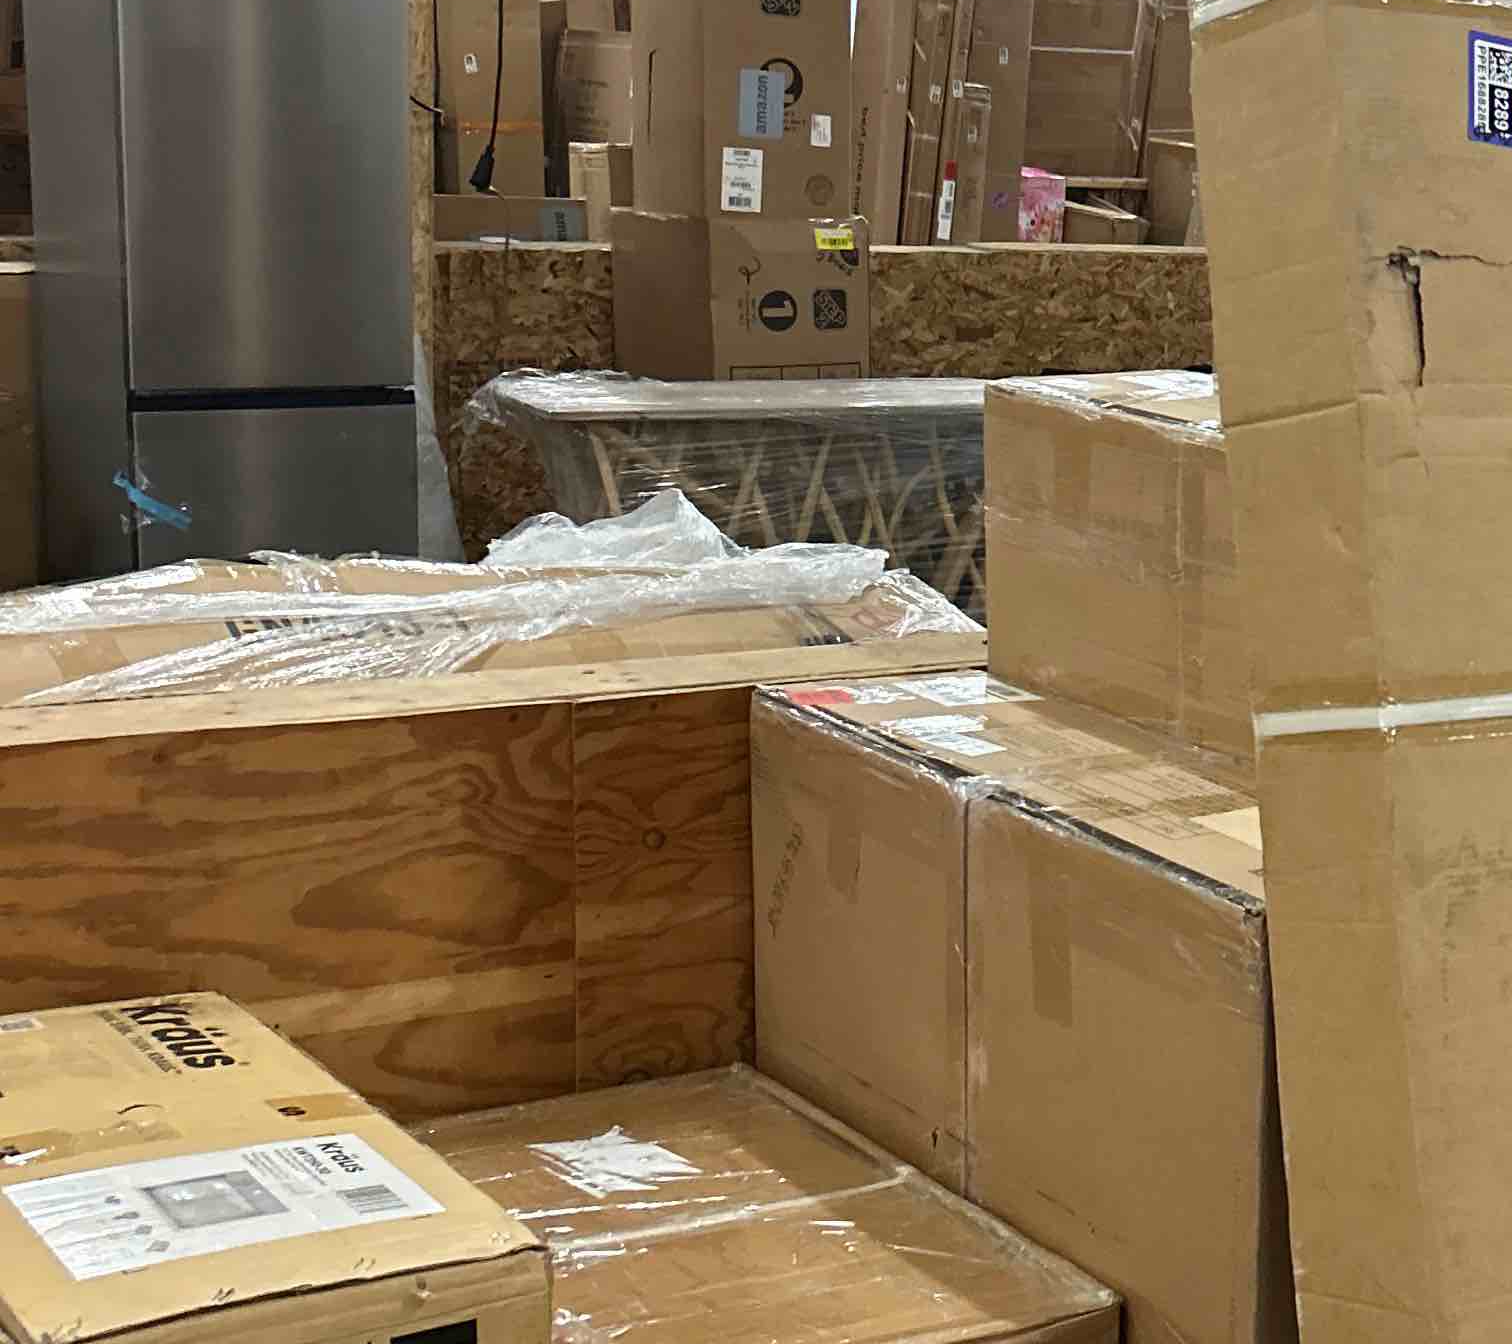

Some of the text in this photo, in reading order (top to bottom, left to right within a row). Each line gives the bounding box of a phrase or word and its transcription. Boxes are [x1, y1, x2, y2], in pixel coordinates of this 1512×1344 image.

[756, 74, 769, 134] amazon
[1493, 88, 1510, 131] 8289
[120, 1002, 235, 1070] Kräus
[315, 1140, 365, 1175] Kräus
